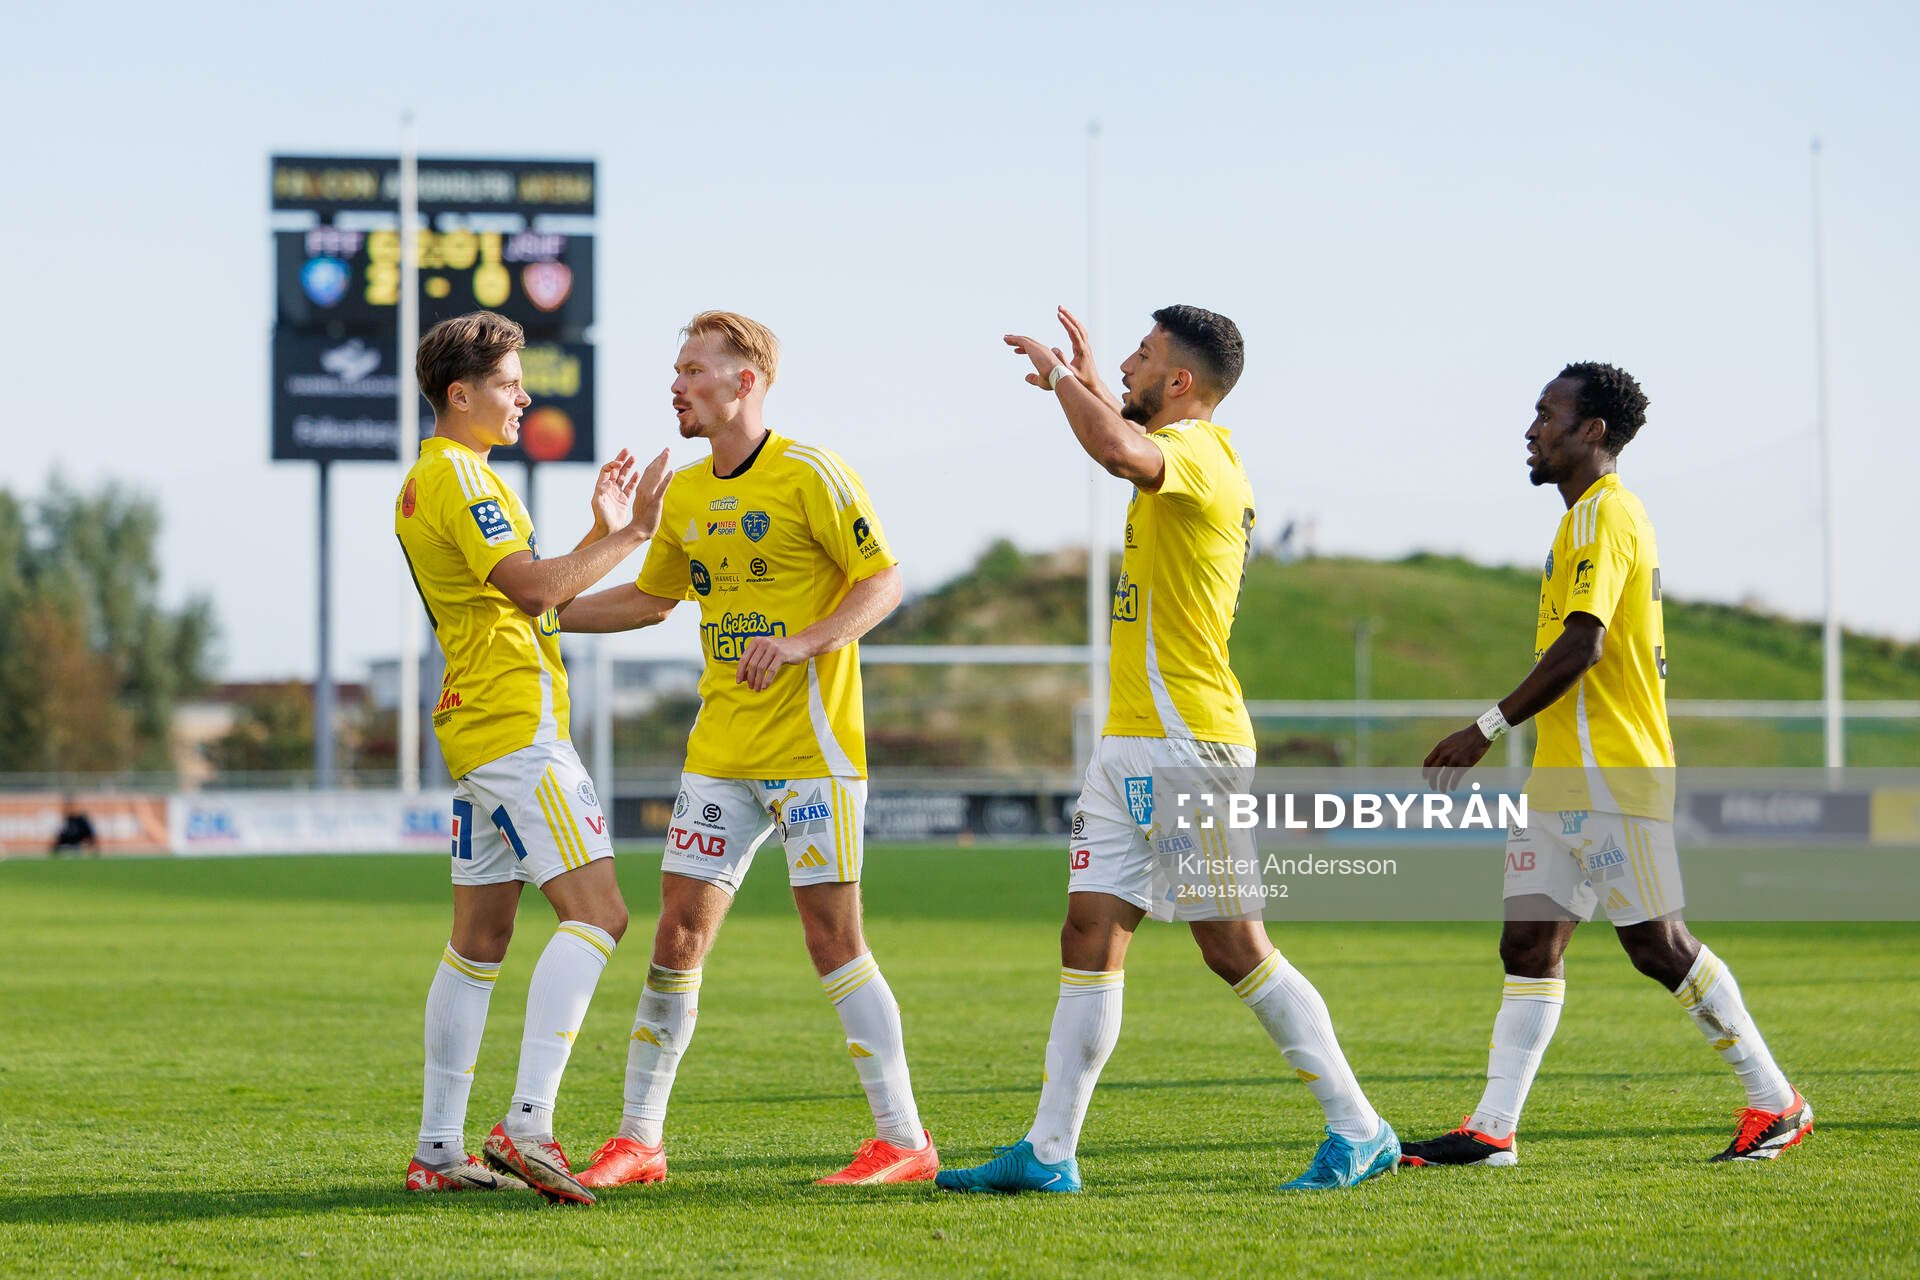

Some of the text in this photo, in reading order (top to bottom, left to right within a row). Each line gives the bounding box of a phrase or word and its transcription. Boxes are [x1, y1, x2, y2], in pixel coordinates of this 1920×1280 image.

[722, 612, 769, 636] Gekås
[790, 803, 829, 823] SKAB
[1157, 836, 1193, 854] SKAB
[1589, 849, 1626, 870] SKAB
